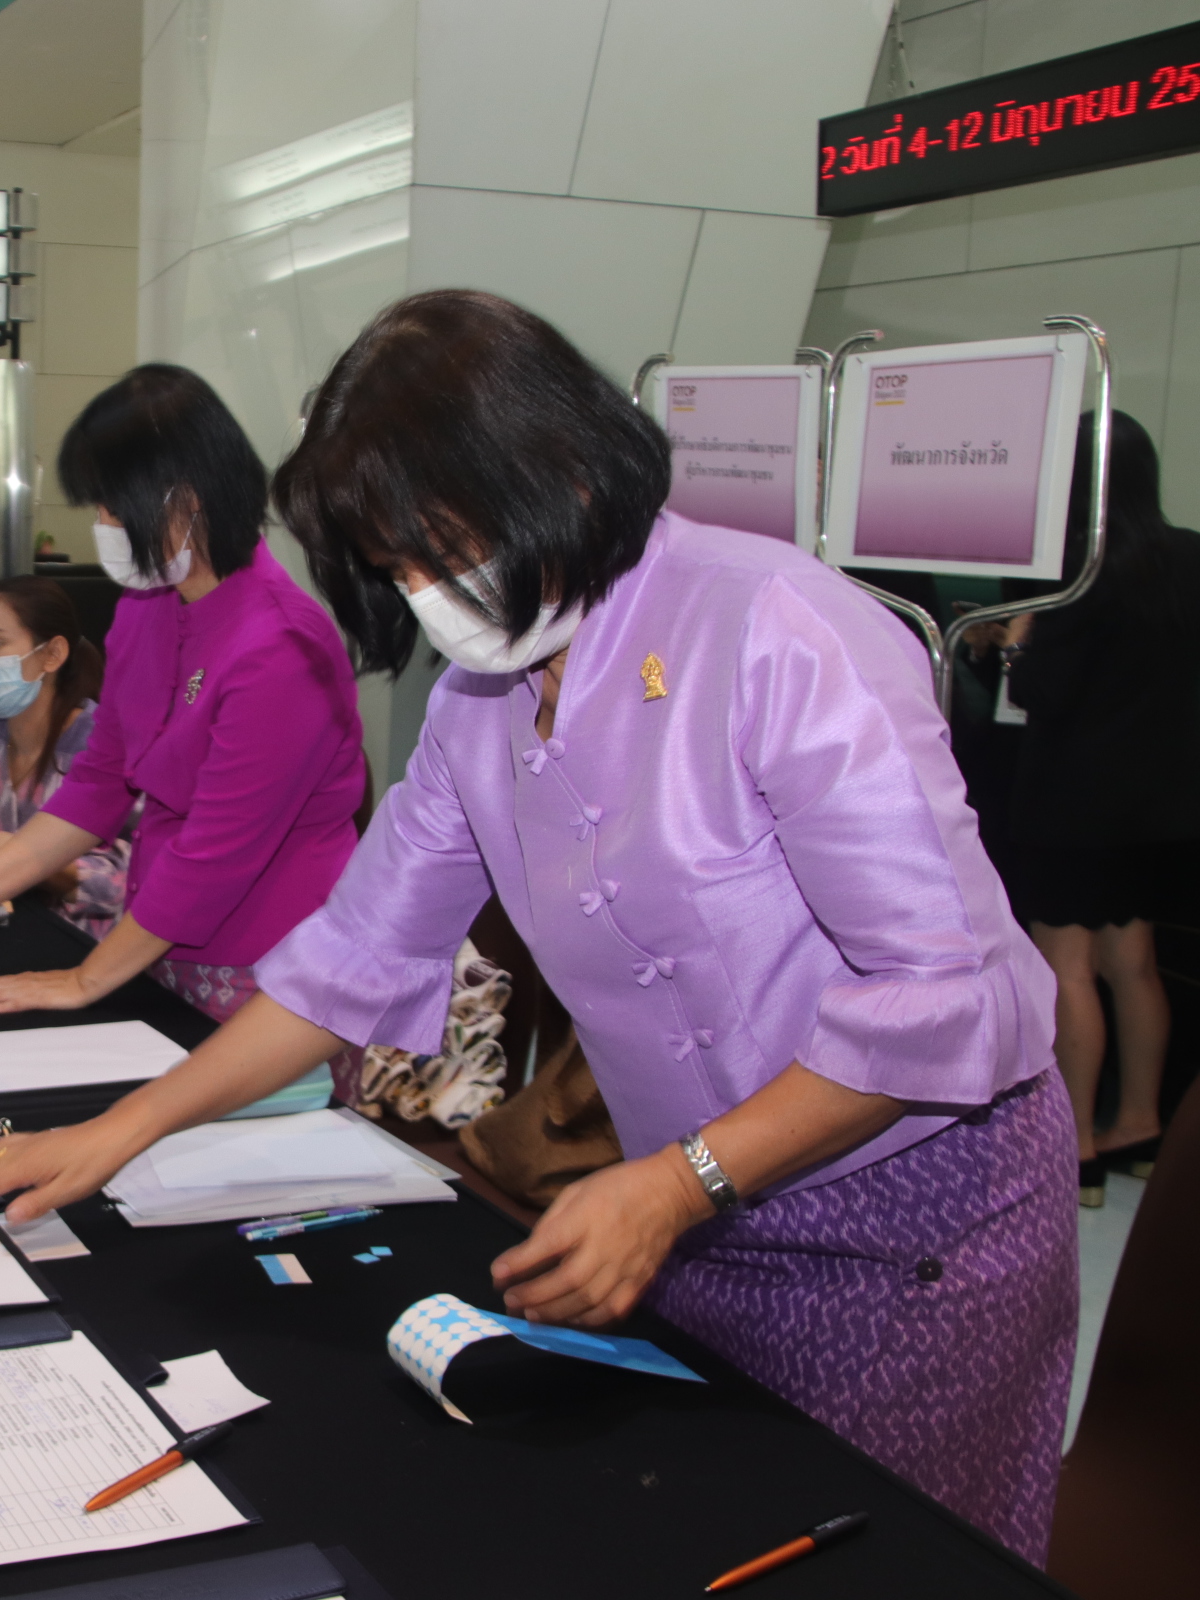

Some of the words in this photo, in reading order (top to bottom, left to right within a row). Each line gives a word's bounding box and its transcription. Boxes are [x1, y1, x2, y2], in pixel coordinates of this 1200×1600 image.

[840, 113, 902, 175] วันที่
[906, 111, 984, 158] 4-12
[990, 80, 1140, 147] มิถุนายน
[875, 374, 909, 389] OTOP
[890, 440, 1009, 466] พัฒนาการจังหวัด
